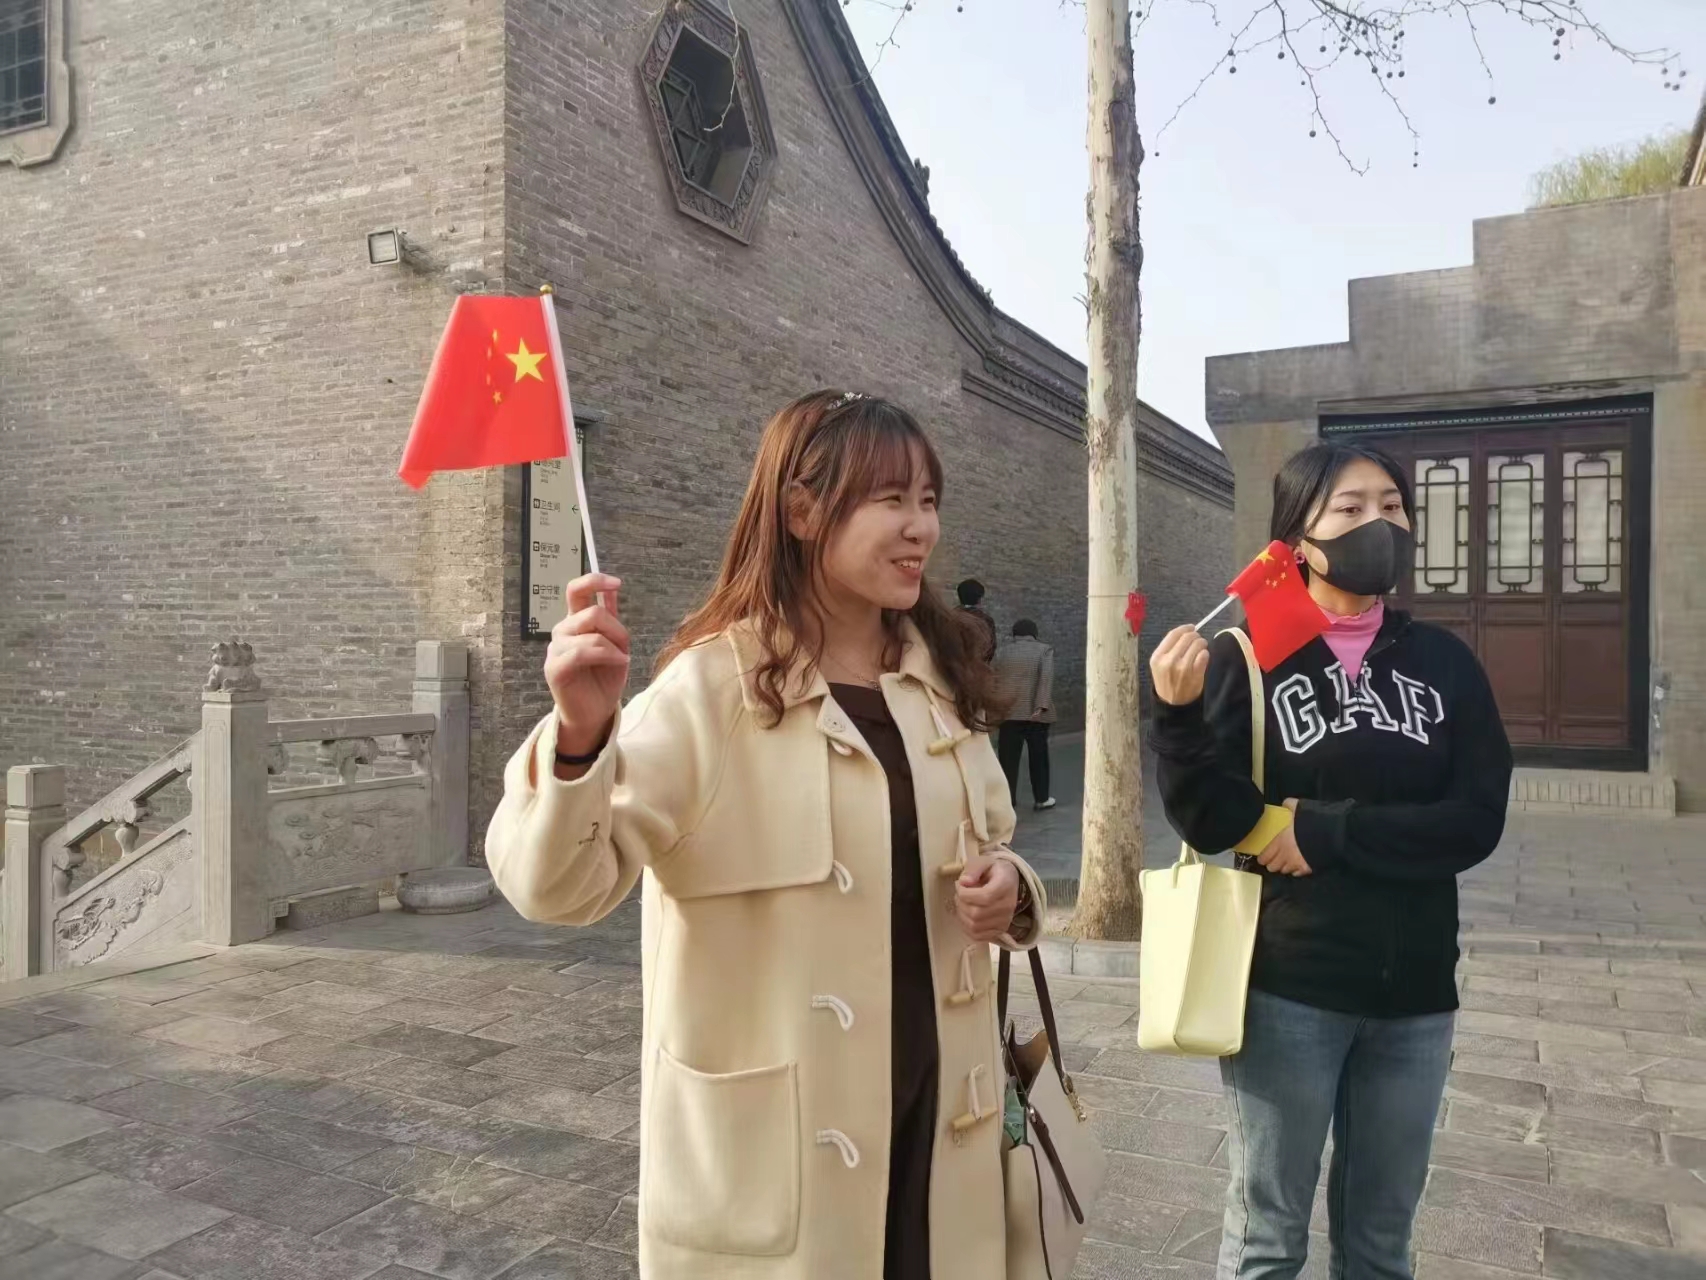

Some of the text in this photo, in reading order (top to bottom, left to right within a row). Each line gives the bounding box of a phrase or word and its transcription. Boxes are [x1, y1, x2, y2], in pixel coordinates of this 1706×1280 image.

[540, 500, 561, 512] 卫生间
[1272, 661, 1444, 754] GAP
